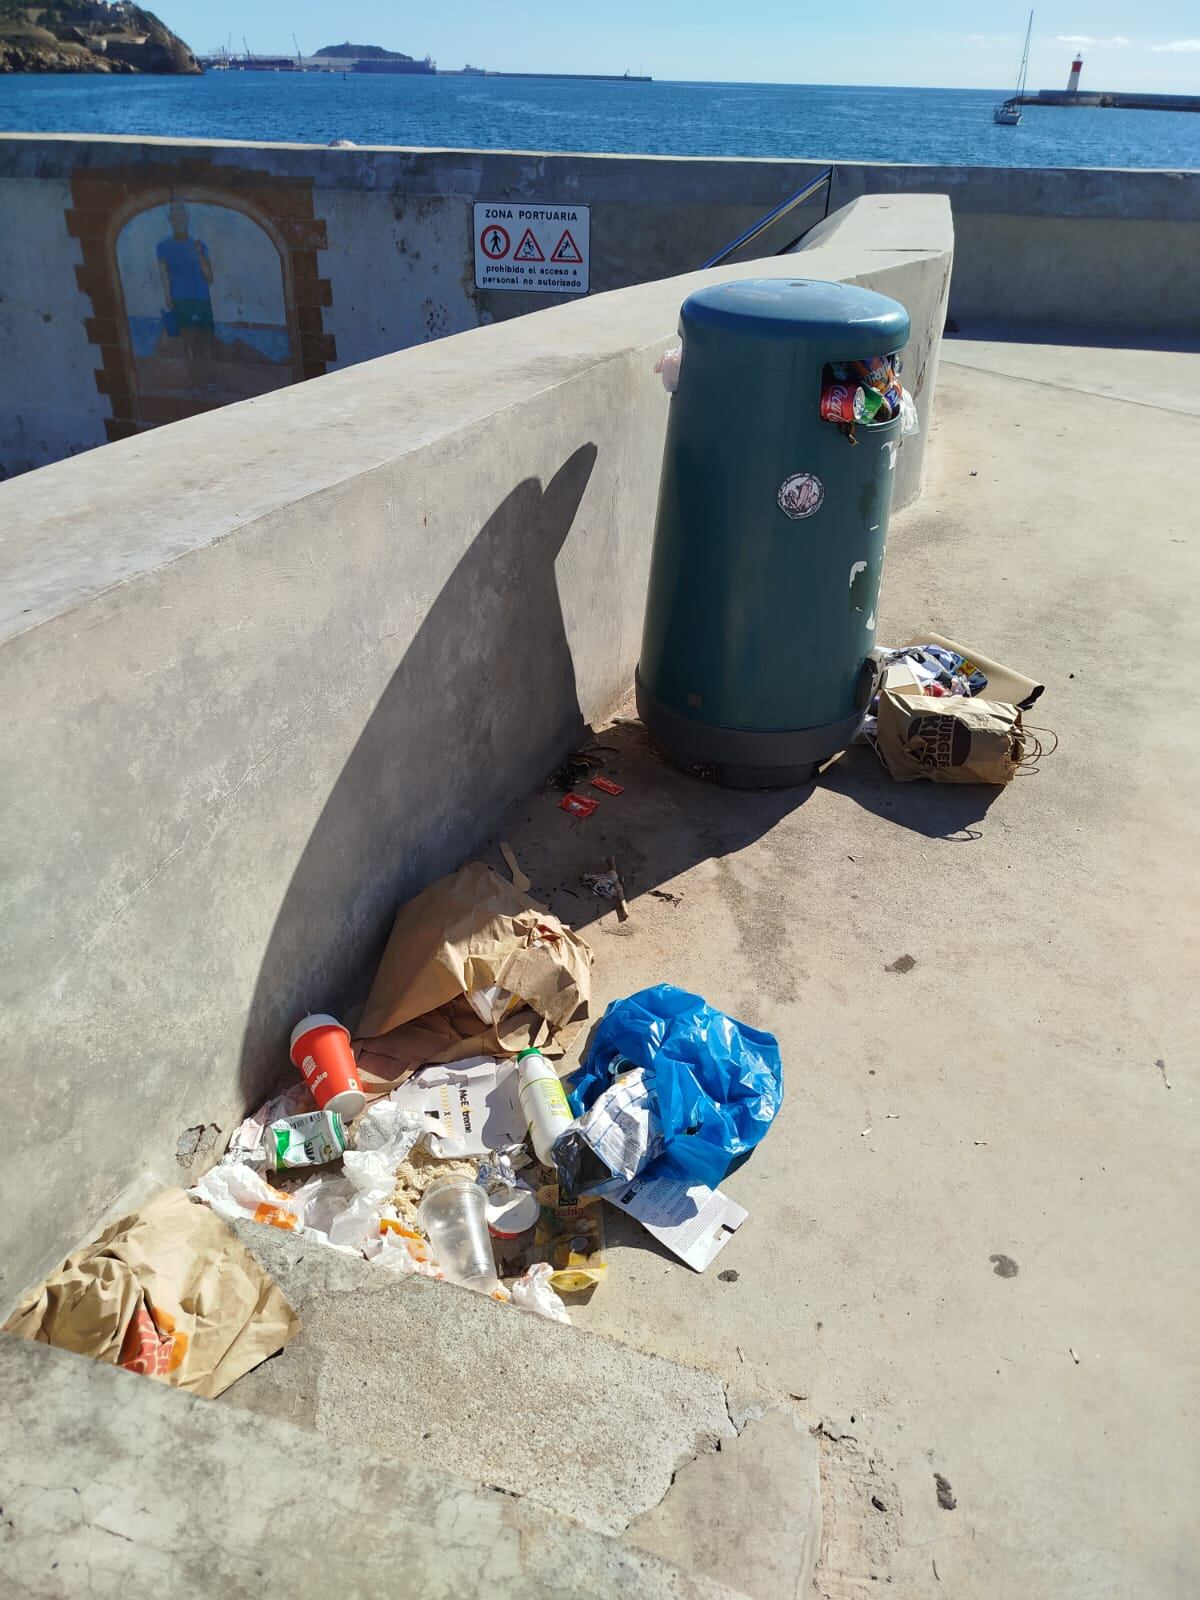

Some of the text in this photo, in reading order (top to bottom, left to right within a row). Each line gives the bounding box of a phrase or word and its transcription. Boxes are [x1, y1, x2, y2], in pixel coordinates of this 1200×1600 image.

[485, 209, 578, 221] ZONA PORTUARIA
[486, 264, 525, 275] prohibido
[528, 265, 536, 274] el
[540, 268, 569, 276] acceso
[482, 276, 519, 286] personal
[537, 277, 582, 288] autorizado
[919, 715, 939, 768] KING
[937, 715, 955, 768] BURGER
